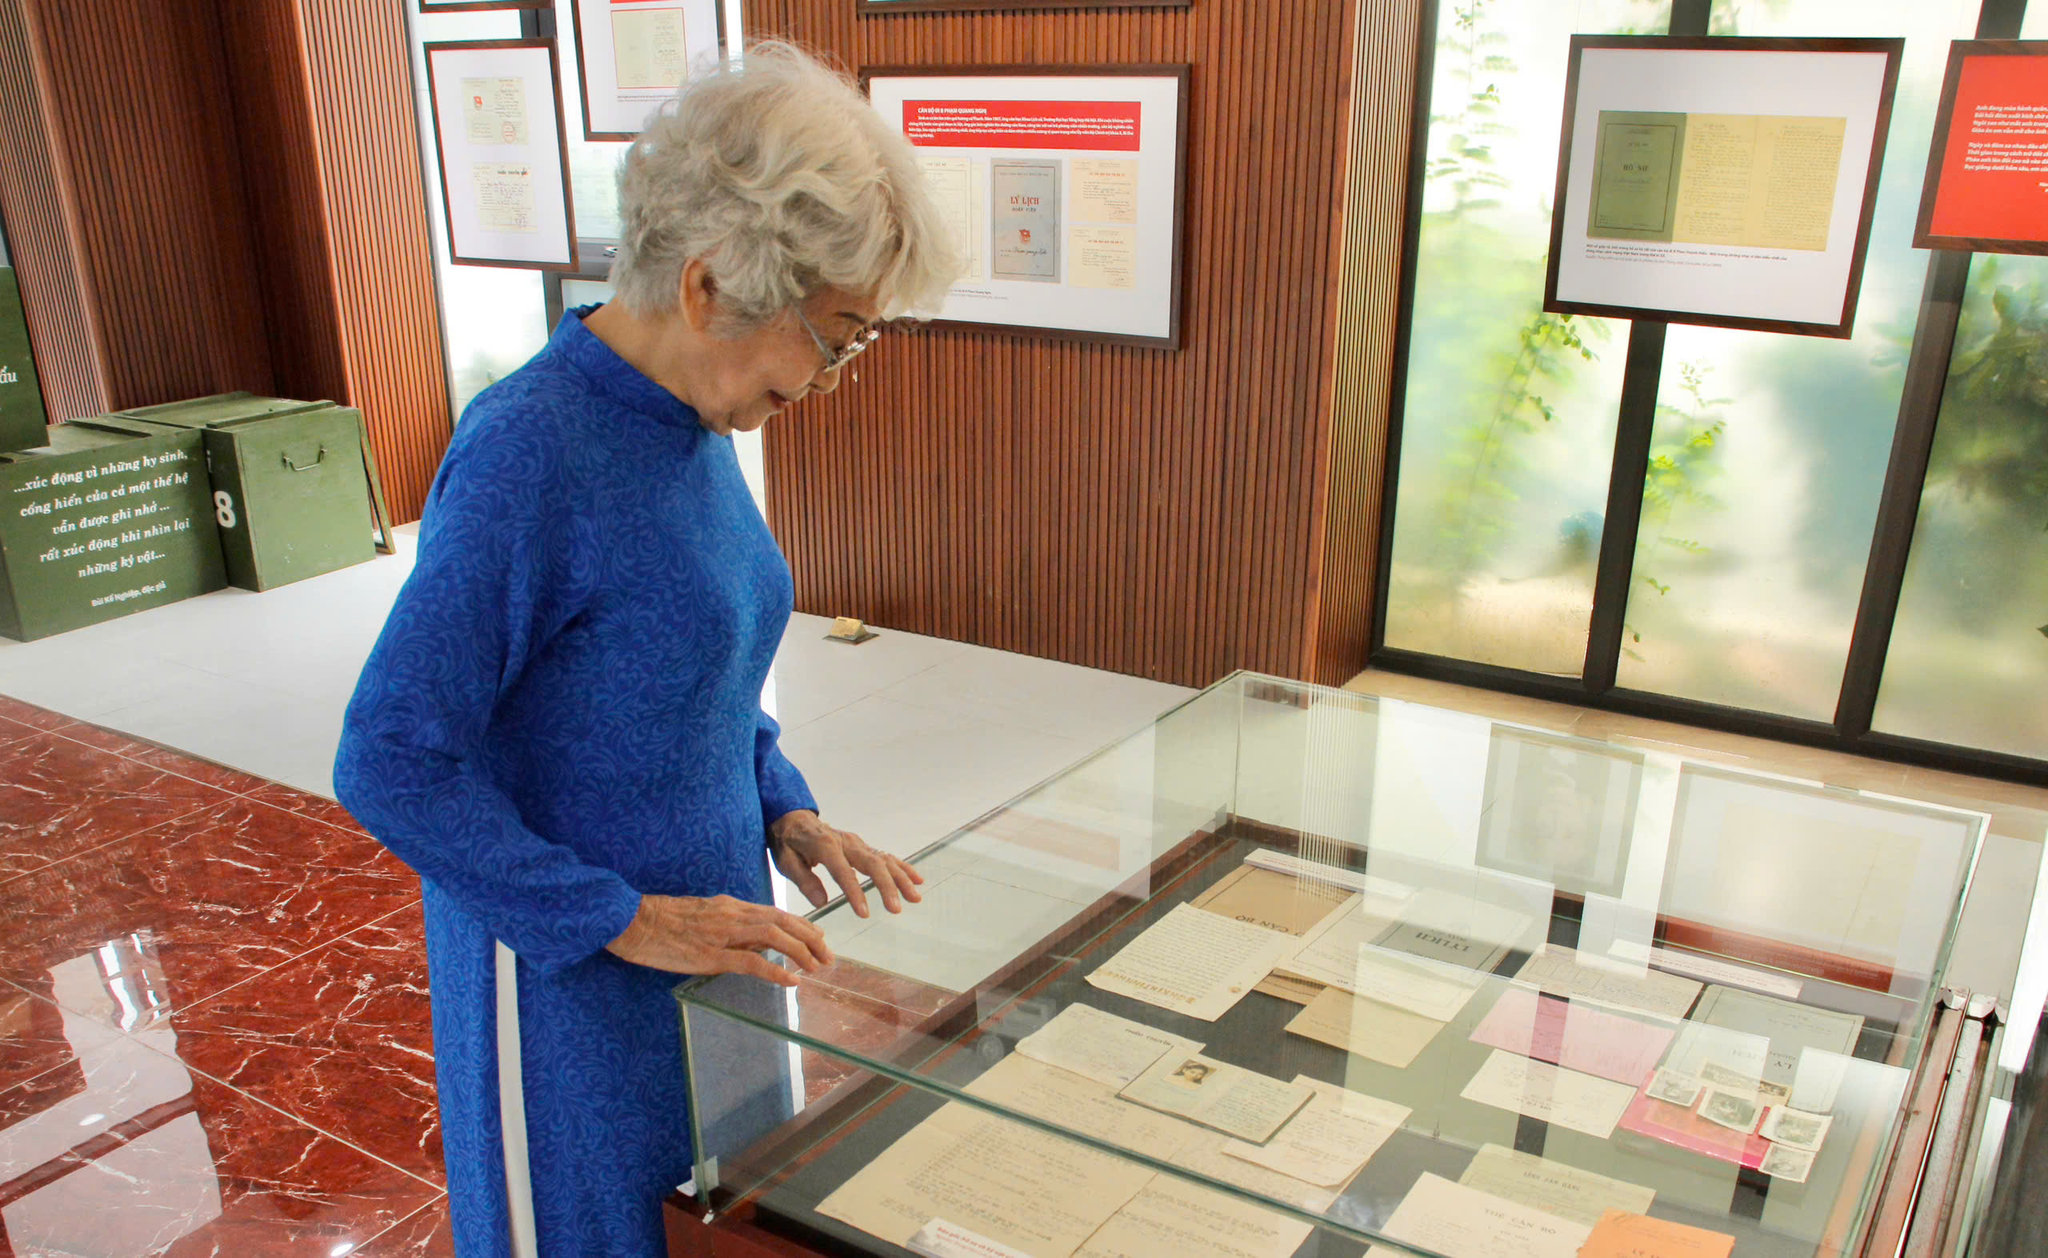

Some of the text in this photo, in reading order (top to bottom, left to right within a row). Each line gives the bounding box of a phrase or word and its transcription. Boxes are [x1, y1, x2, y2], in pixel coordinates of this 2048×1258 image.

[52, 472, 83, 484] động
[86, 466, 98, 478] vì
[100, 460, 140, 476] những
[143, 456, 156, 468] hy
[160, 450, 188, 463] sinh,
[20, 502, 51, 517] cống
[55, 493, 82, 510] hiến
[86, 490, 108, 503] của
[129, 482, 150, 494] một
[154, 473, 173, 489] thế
[175, 472, 189, 485] hệ
[214, 490, 236, 528] 8
[53, 520, 77, 535] vẫn
[80, 516, 109, 530] được
[112, 508, 132, 524] ghi
[40, 518, 190, 563] rất xúc động khi nhìn lại
[78, 562, 118, 578] những
